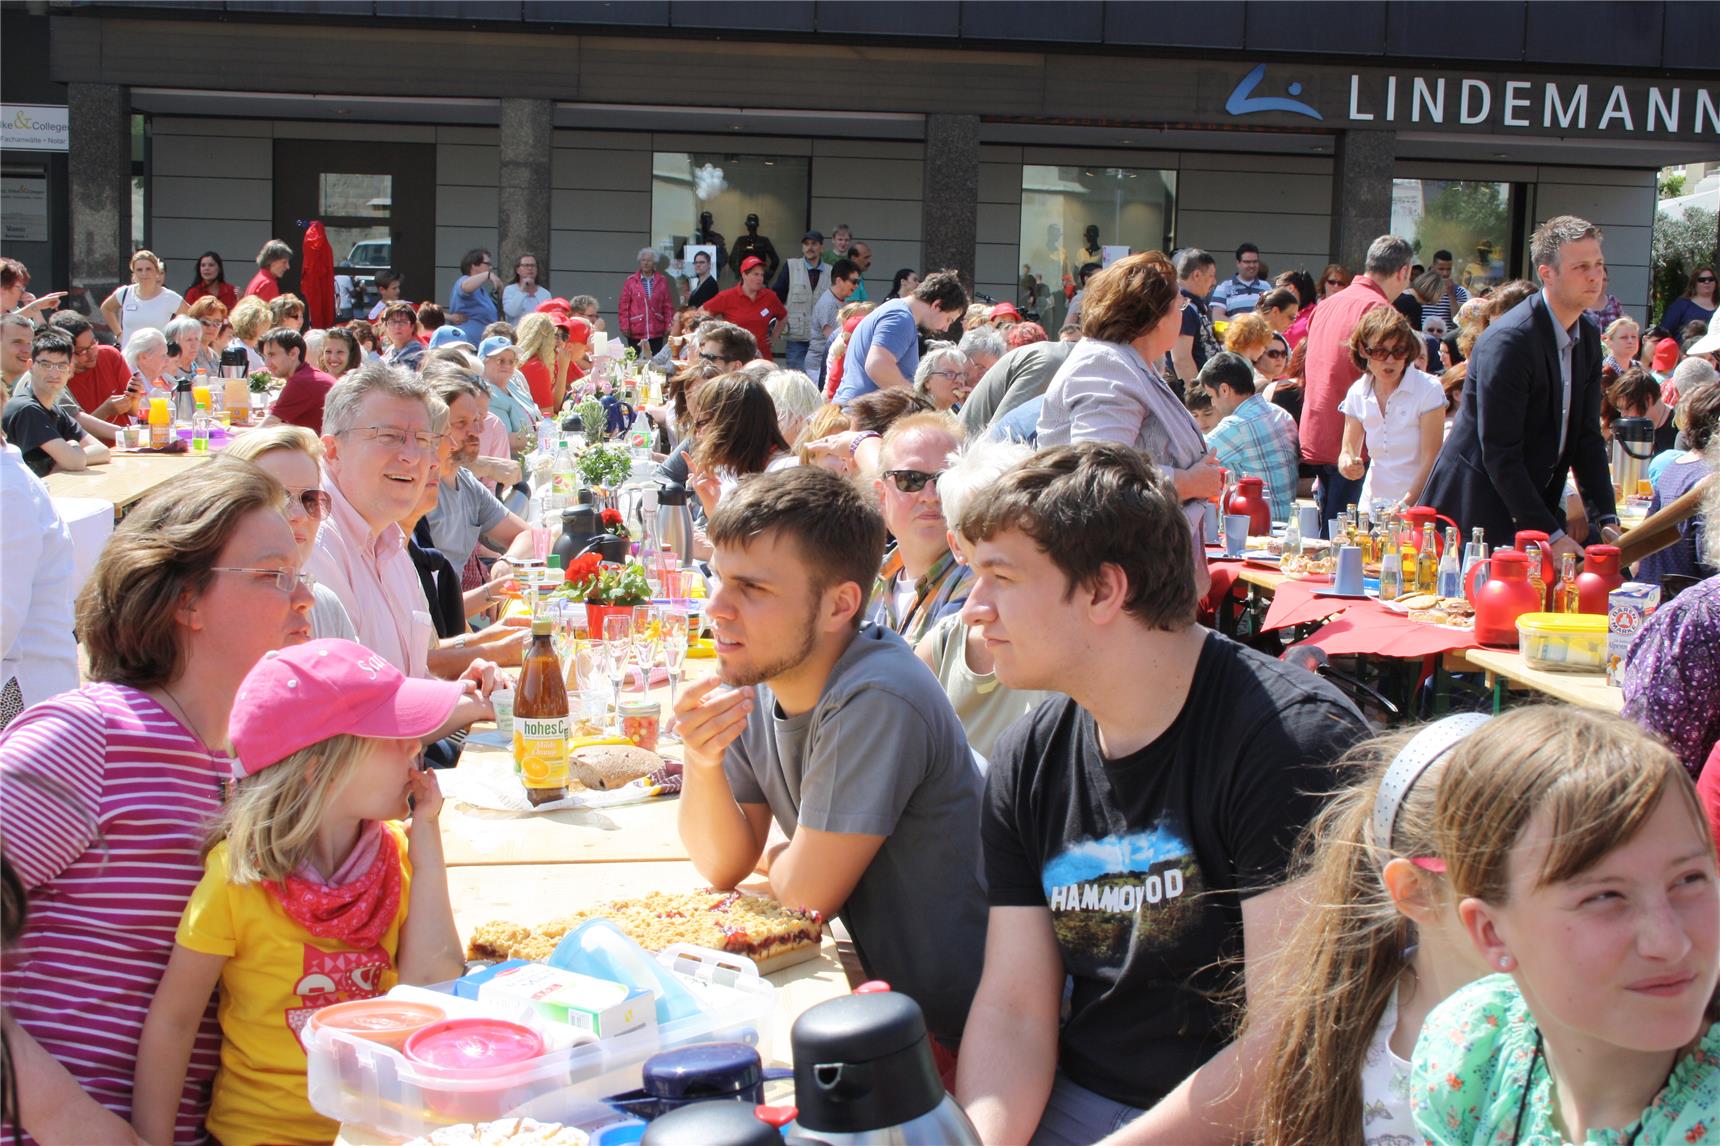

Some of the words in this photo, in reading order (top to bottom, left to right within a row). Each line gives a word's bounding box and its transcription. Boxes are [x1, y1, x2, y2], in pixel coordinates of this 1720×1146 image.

[1349, 75, 1720, 134] LINDEMANN
[525, 720, 557, 735] hohes
[558, 720, 564, 734] C
